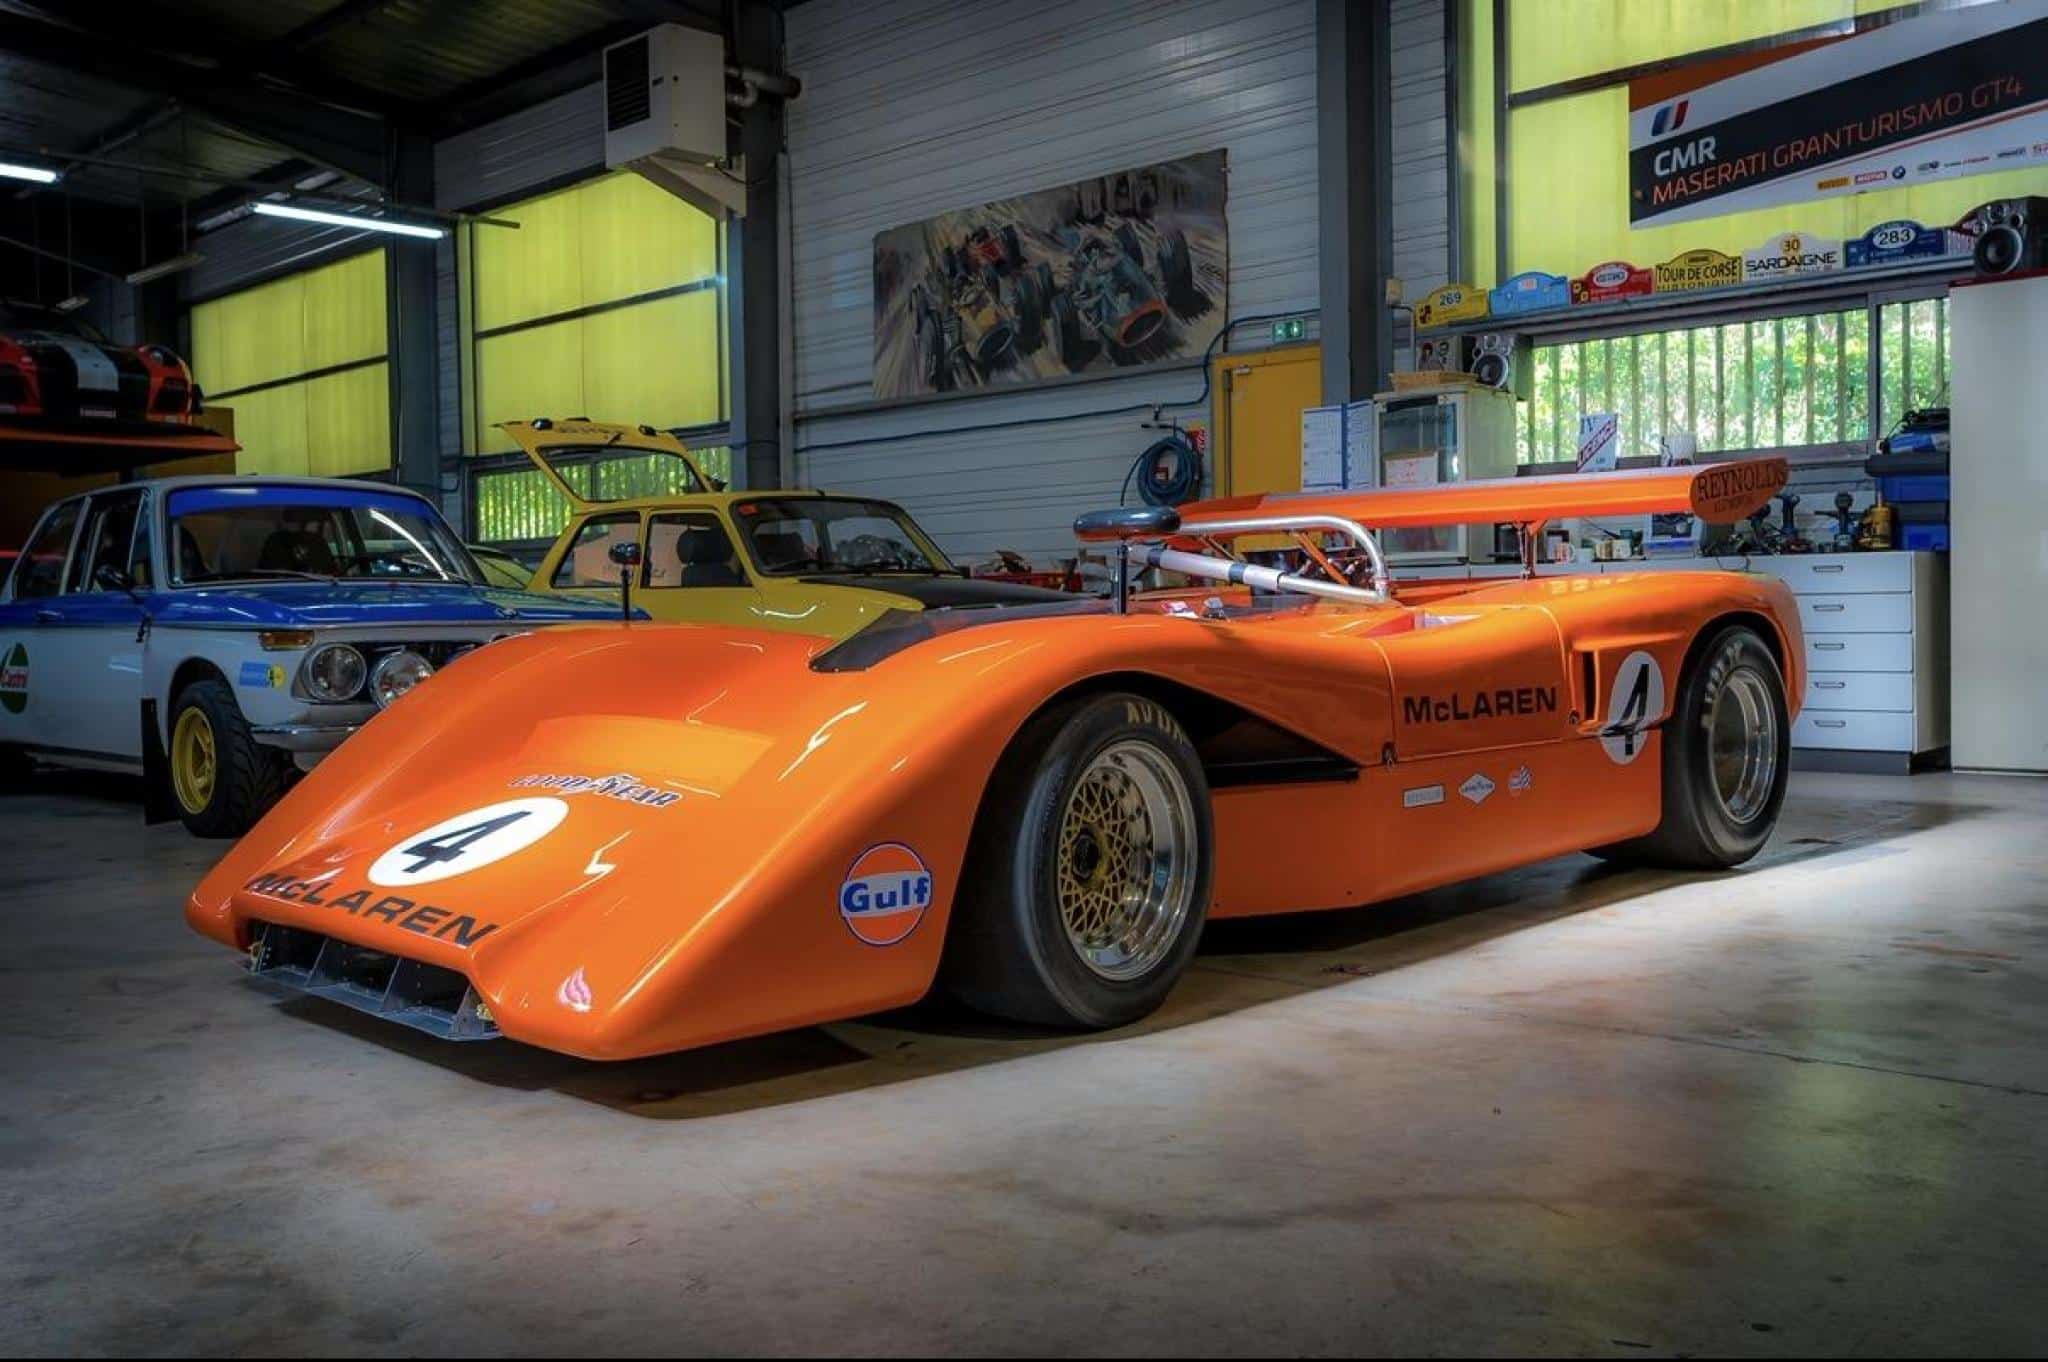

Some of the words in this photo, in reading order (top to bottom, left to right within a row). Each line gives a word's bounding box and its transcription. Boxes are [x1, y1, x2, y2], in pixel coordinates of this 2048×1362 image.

[1653, 152, 1767, 205] MASERATI
[1773, 92, 1963, 168] GRANTURISMO
[1971, 76, 2024, 108] GT4
[1654, 136, 1717, 177] CMR
[1783, 239, 1800, 253] 30
[1879, 228, 1912, 246] 283
[1656, 266, 1687, 283] TOUR
[1688, 267, 1701, 281] DE
[1703, 260, 1738, 279] CORSE
[1745, 251, 1838, 272] SARDAIGNE
[1439, 291, 1462, 306] 269
[1403, 687, 1558, 724] McLAREN
[1601, 664, 1649, 756] 4
[401, 810, 533, 873] 4
[243, 872, 499, 945] McLAREN
[843, 877, 930, 913] Gulf
